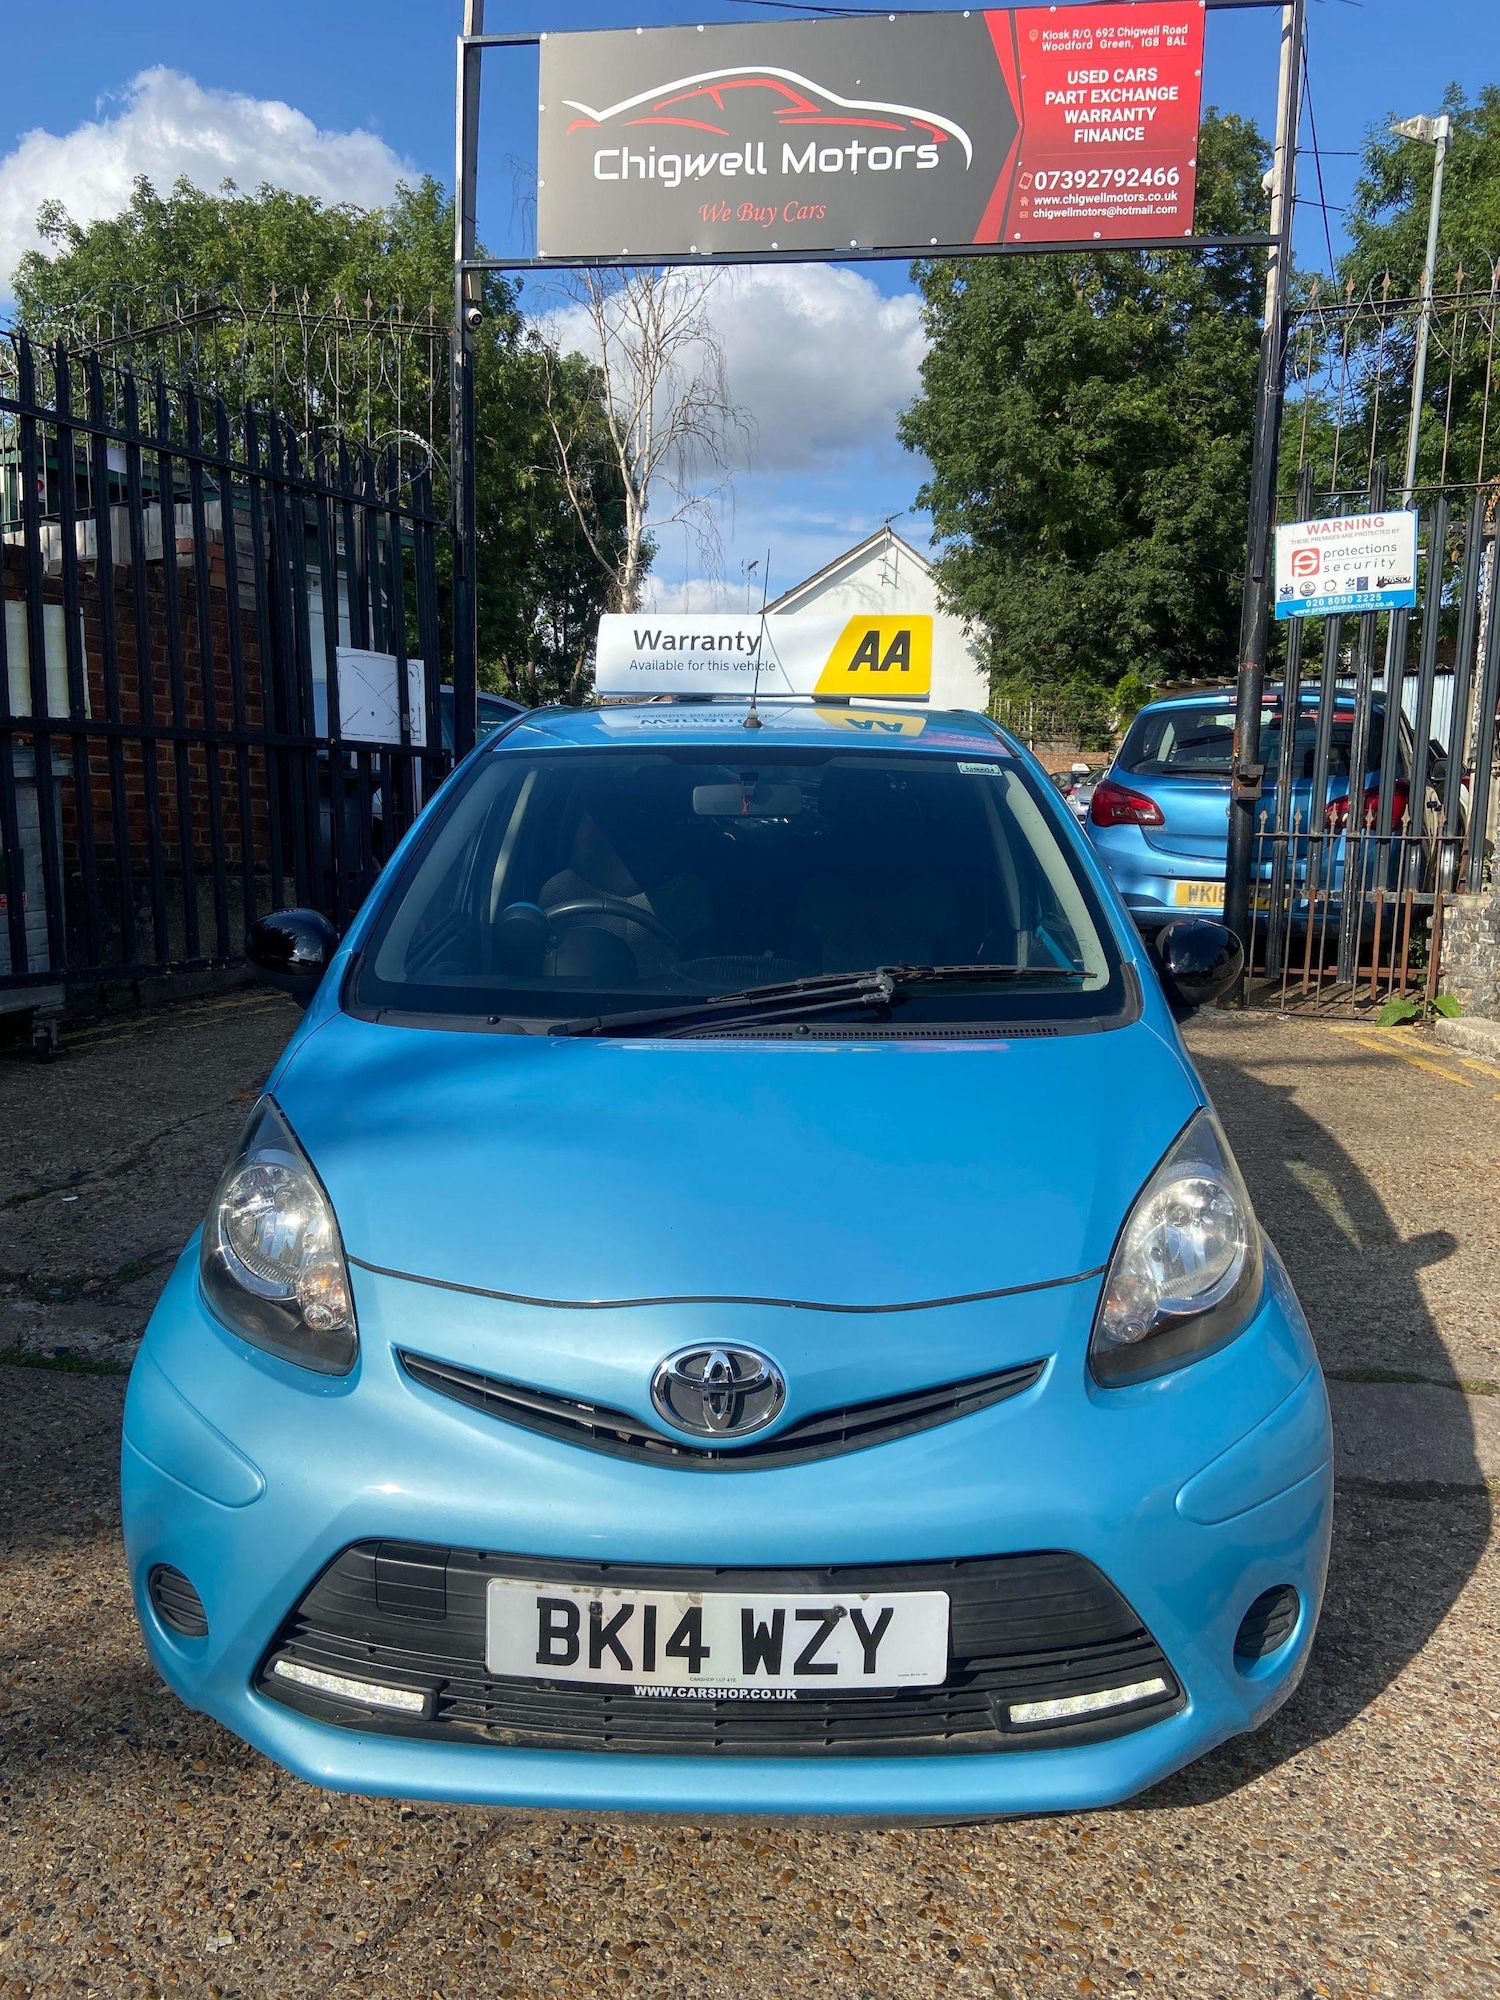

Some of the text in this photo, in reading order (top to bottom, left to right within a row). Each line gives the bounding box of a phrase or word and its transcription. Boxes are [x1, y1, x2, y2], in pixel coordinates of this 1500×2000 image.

[1042, 24, 1188, 41] Kiosk R/O, 692 Chigwell Road
[1042, 36, 1187, 51] Woodford Green, IG8 8AL
[1067, 67, 1158, 84] USED CARS
[1044, 86, 1179, 105] PART EXCHANGE
[1064, 107, 1157, 123] WARRANTY
[1074, 127, 1145, 143] FINANCE
[593, 140, 939, 188] Chigwell Motors
[1034, 167, 1180, 191] 07392792466
[1034, 190, 1178, 206] www.chigwellmotors.co.uk
[699, 200, 826, 228] We Buy Cars
[1032, 206, 1178, 219] chigwellmotors@hotmail.com
[1307, 516, 1385, 536] WARNING
[1291, 537, 1310, 545] THESE
[1311, 534, 1340, 543] PREMISES
[1355, 528, 1391, 538] PROTECTED
[1392, 527, 1400, 535] BY
[1323, 543, 1397, 560] protections
[1323, 558, 1396, 573] security
[1294, 600, 1395, 616] www.protectionsecurity.co.uk
[1306, 593, 1382, 608] 020 8090 2225
[634, 629, 762, 656] Warranty
[847, 630, 911, 672] AA
[630, 659, 776, 671] Available for this vehicle
[535, 1596, 894, 1676] BK14 WZY
[634, 1685, 798, 1701] WWW.CARSHOP.CO.UK
